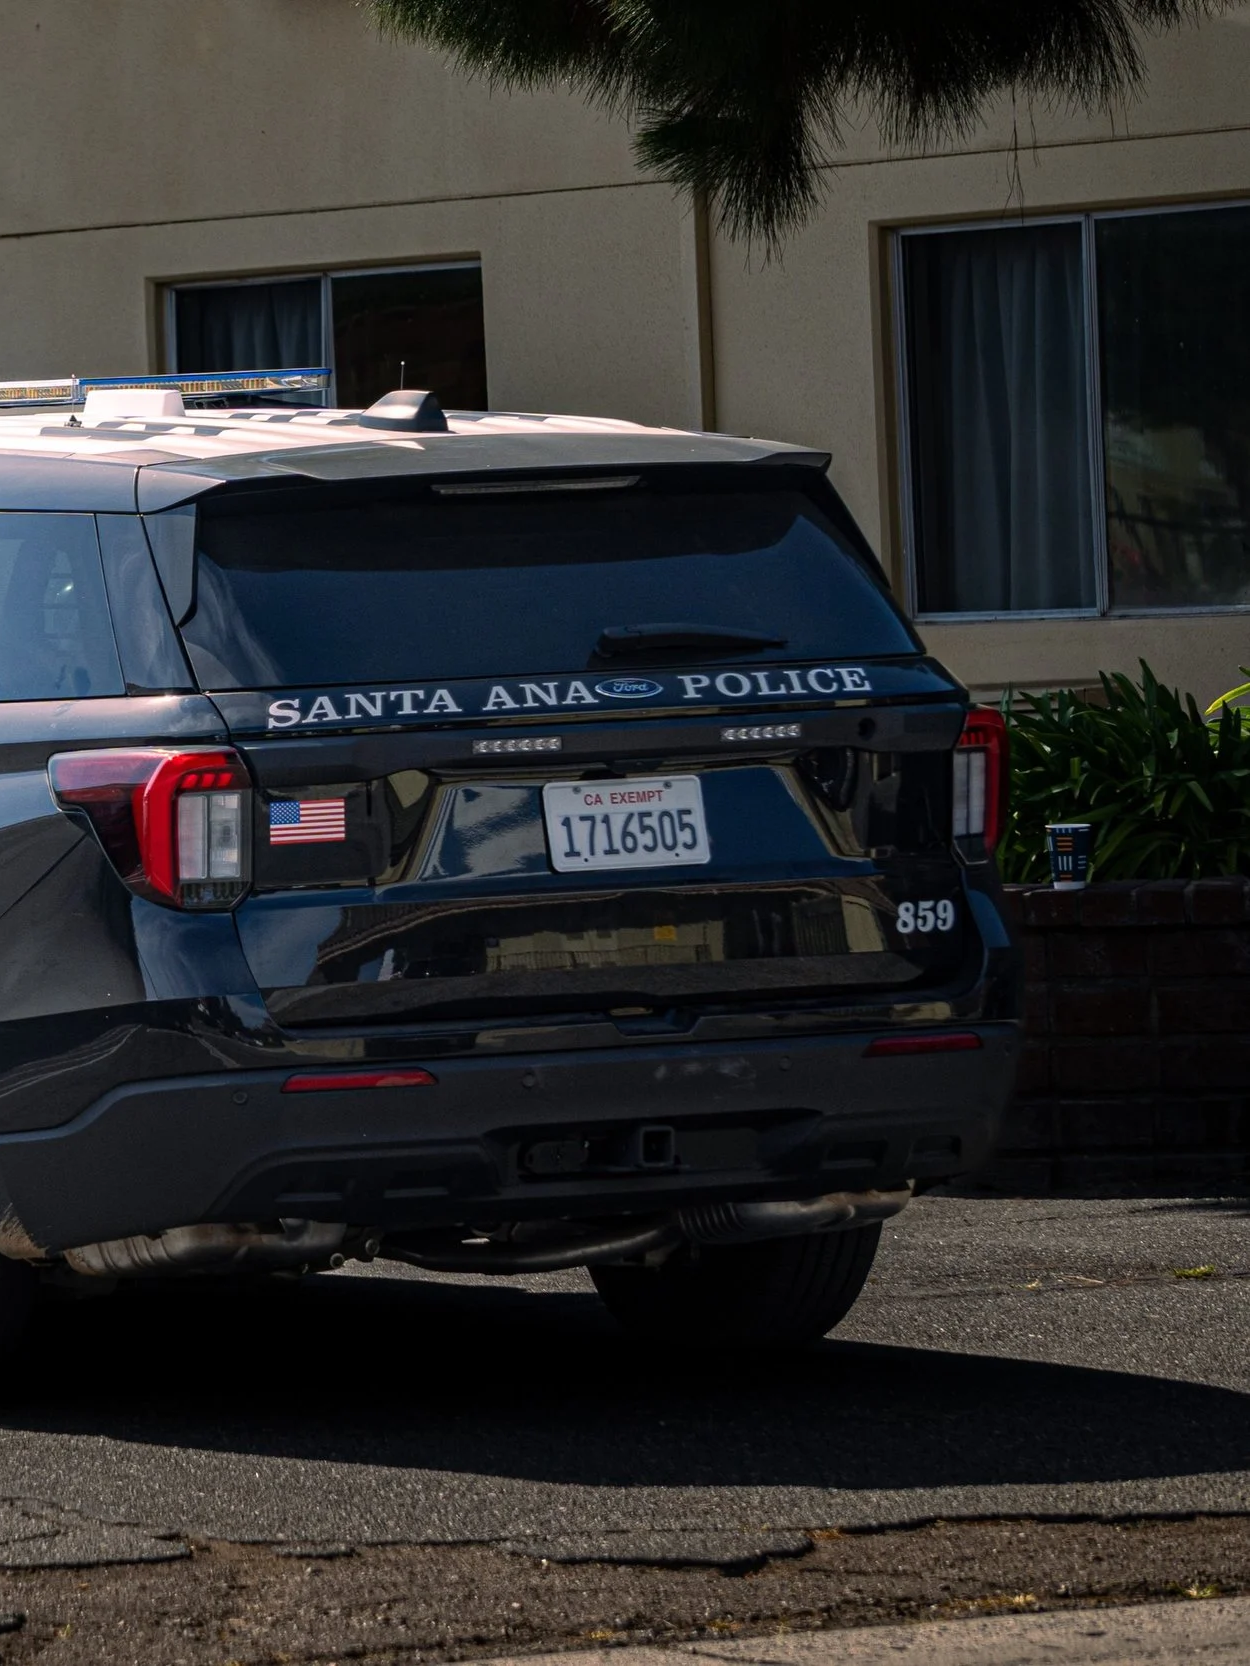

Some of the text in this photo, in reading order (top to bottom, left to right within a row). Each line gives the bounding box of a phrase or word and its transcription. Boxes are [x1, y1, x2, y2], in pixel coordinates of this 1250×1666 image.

[267, 667, 873, 729] SANTA ANA POLICE
[613, 682, 649, 692] Ford
[583, 790, 663, 806] CA EXEMPT
[561, 809, 698, 858] 1716505
[896, 899, 955, 933] 859
